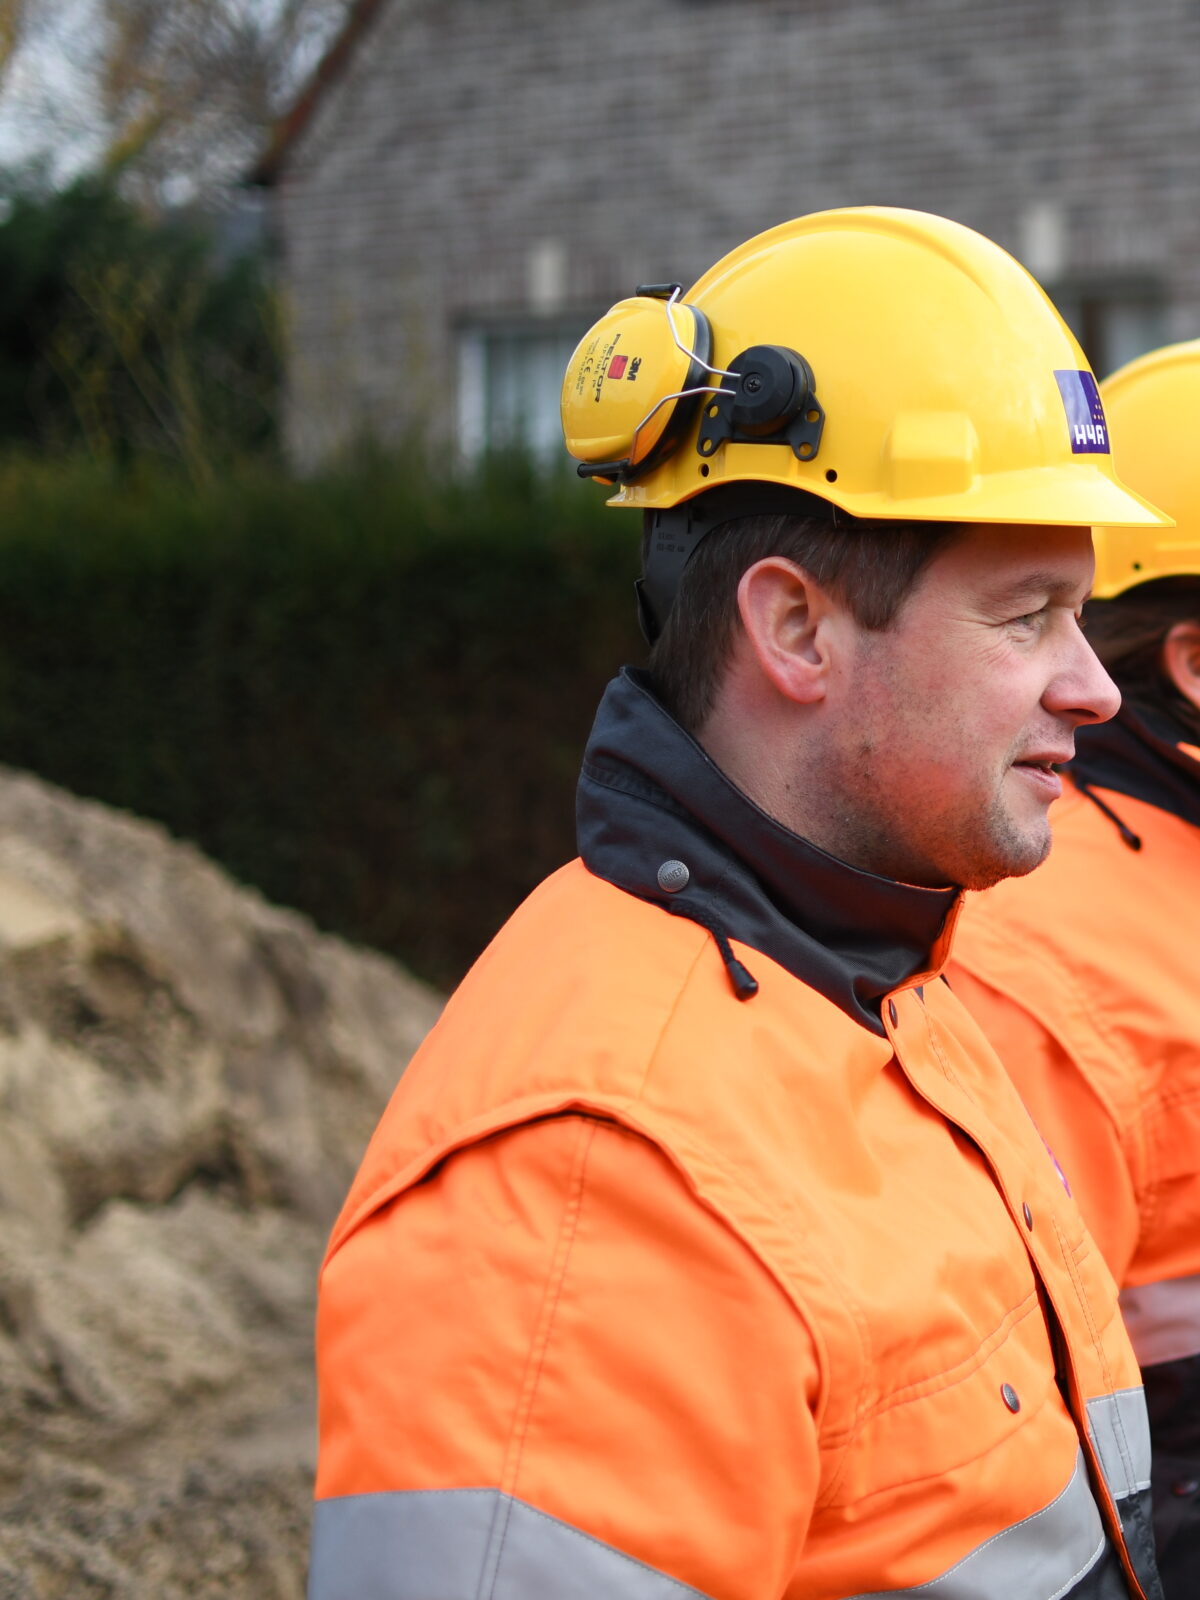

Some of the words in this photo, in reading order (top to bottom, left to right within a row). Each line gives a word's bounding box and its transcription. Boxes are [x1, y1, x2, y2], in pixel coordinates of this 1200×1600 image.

[595, 334, 621, 403] PELTOR
[627, 357, 642, 381] 3M
[1074, 424, 1105, 445] H4A
[663, 867, 682, 881] HAVEP
